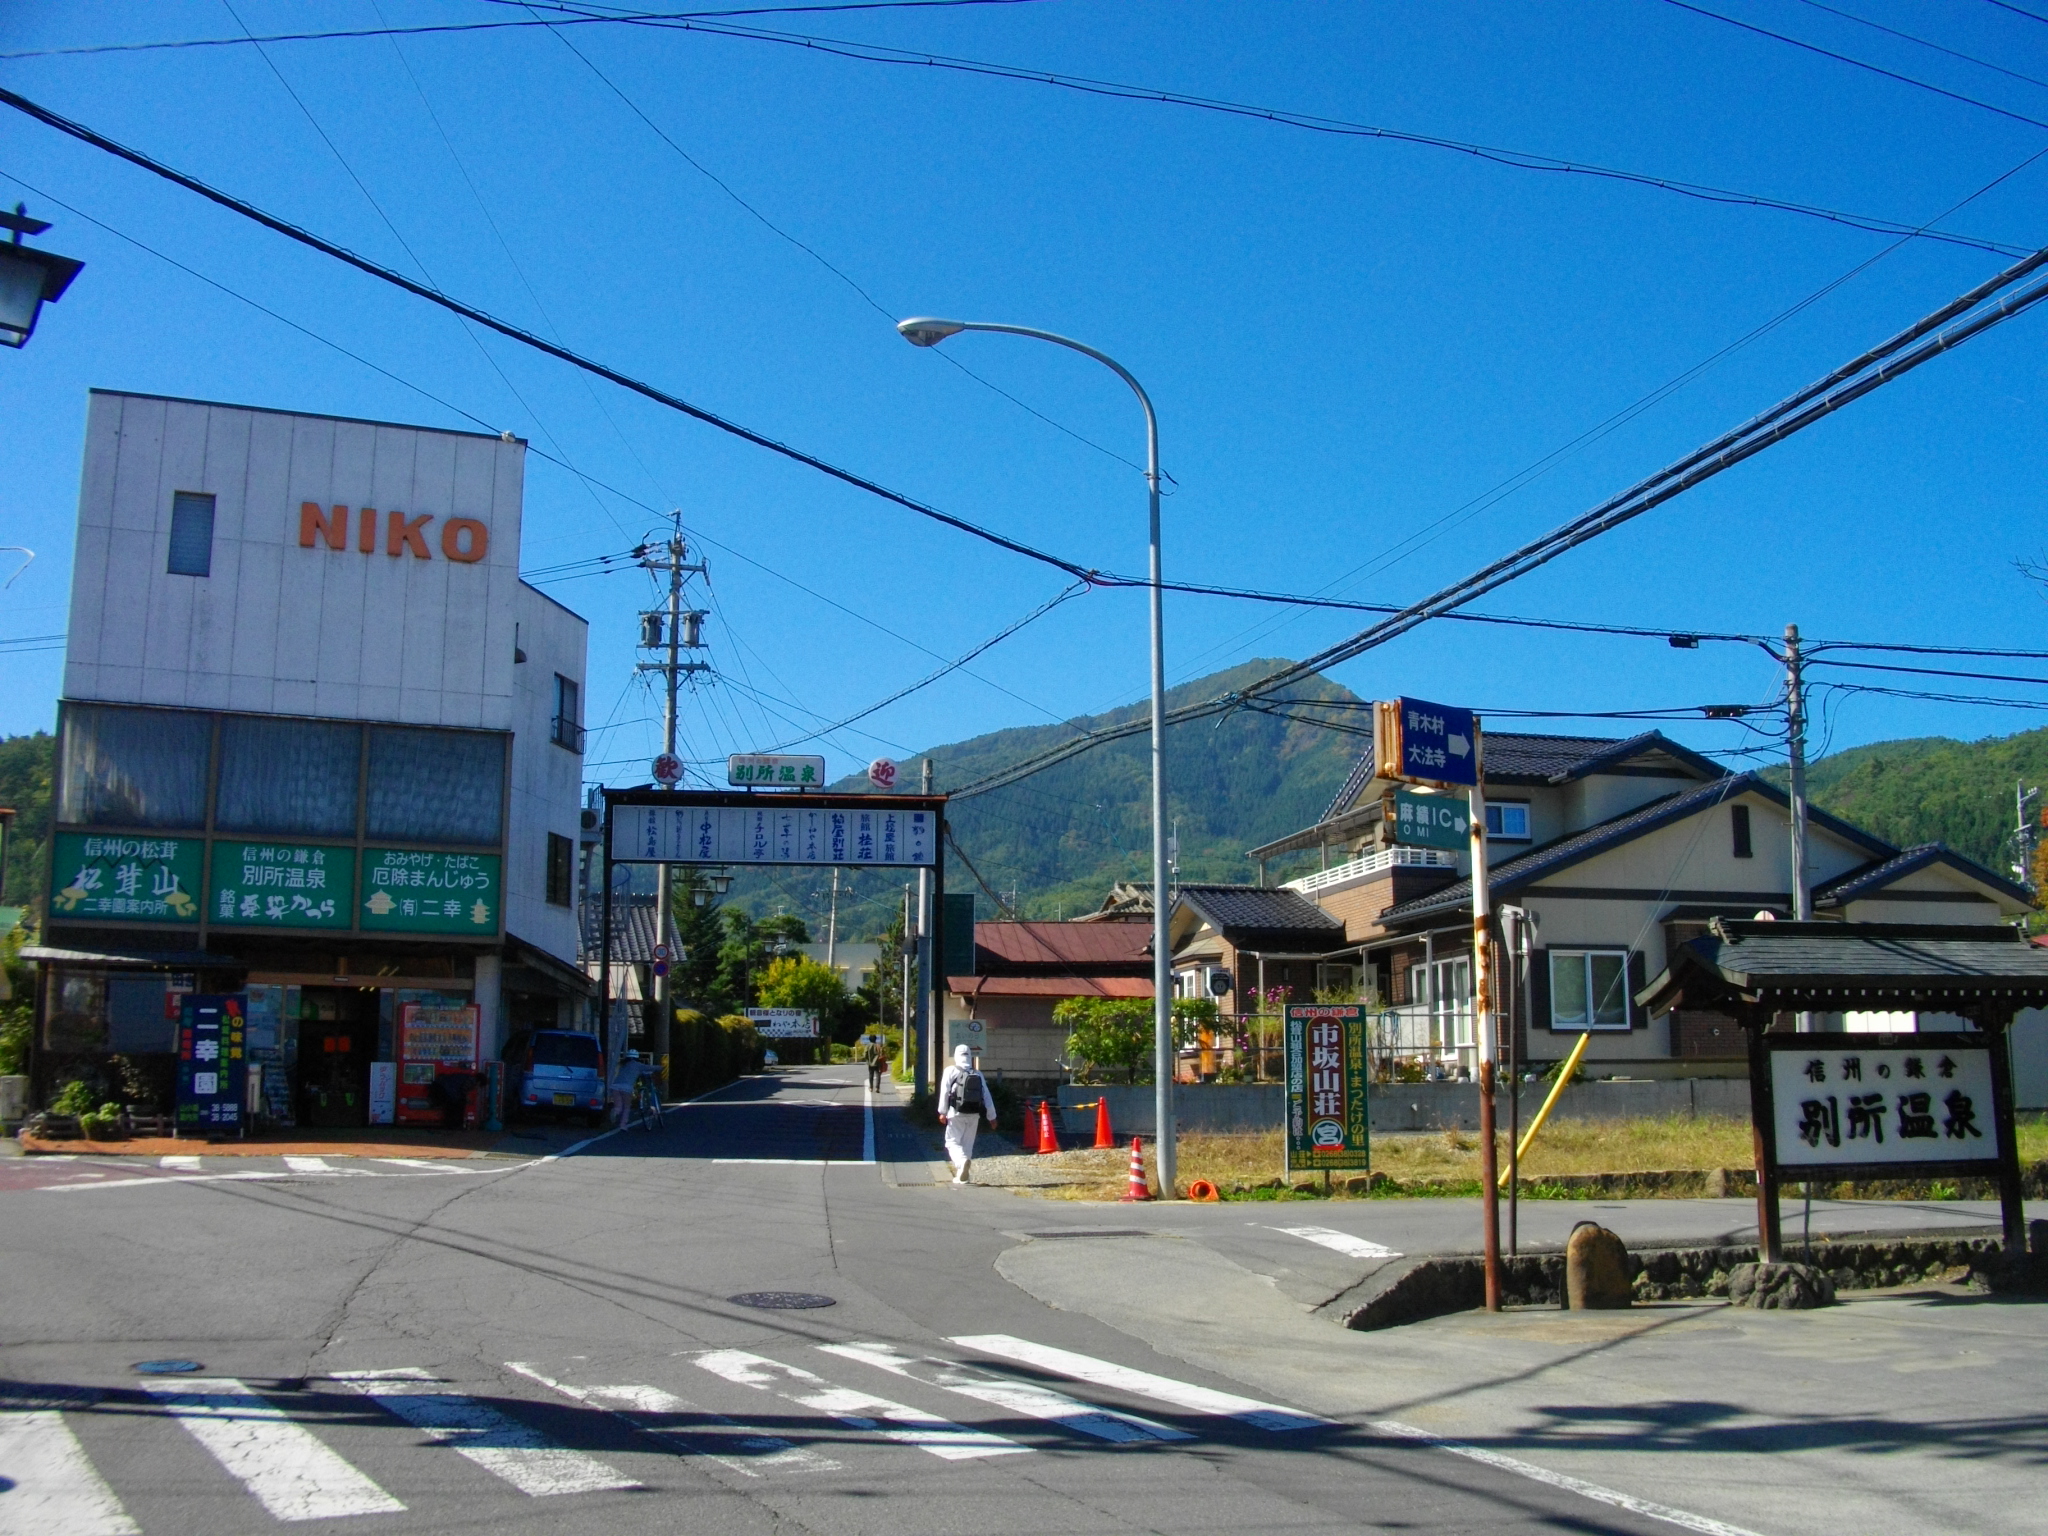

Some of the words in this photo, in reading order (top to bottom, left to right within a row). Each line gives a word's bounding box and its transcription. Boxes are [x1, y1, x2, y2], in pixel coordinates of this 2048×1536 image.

[300, 502, 488, 563] NIKO
[1407, 710, 1445, 736] 青木村
[655, 756, 680, 779] 歓
[1408, 743, 1447, 769] 大法寺
[735, 764, 818, 783] 別所温泉
[872, 762, 896, 786] 迎
[1400, 802, 1452, 828] 麻績IC
[84, 838, 179, 860] 信州の松茸
[242, 846, 326, 865] 信州の鎌倉
[70, 862, 180, 897] 松茸山
[242, 865, 326, 889] 別所温泉
[372, 867, 490, 889] 厄除まんじゅう
[83, 897, 169, 915] 二幸園案内所
[219, 888, 236, 918] 銘菓
[1290, 1007, 1359, 1018] 信州の鎌倉
[195, 1007, 220, 1095] 二幸園
[1312, 1022, 1341, 1116] 市坂山荘
[1804, 1055, 1958, 1084] 信州の鎌倉
[1799, 1090, 1983, 1148] 別所温泉
